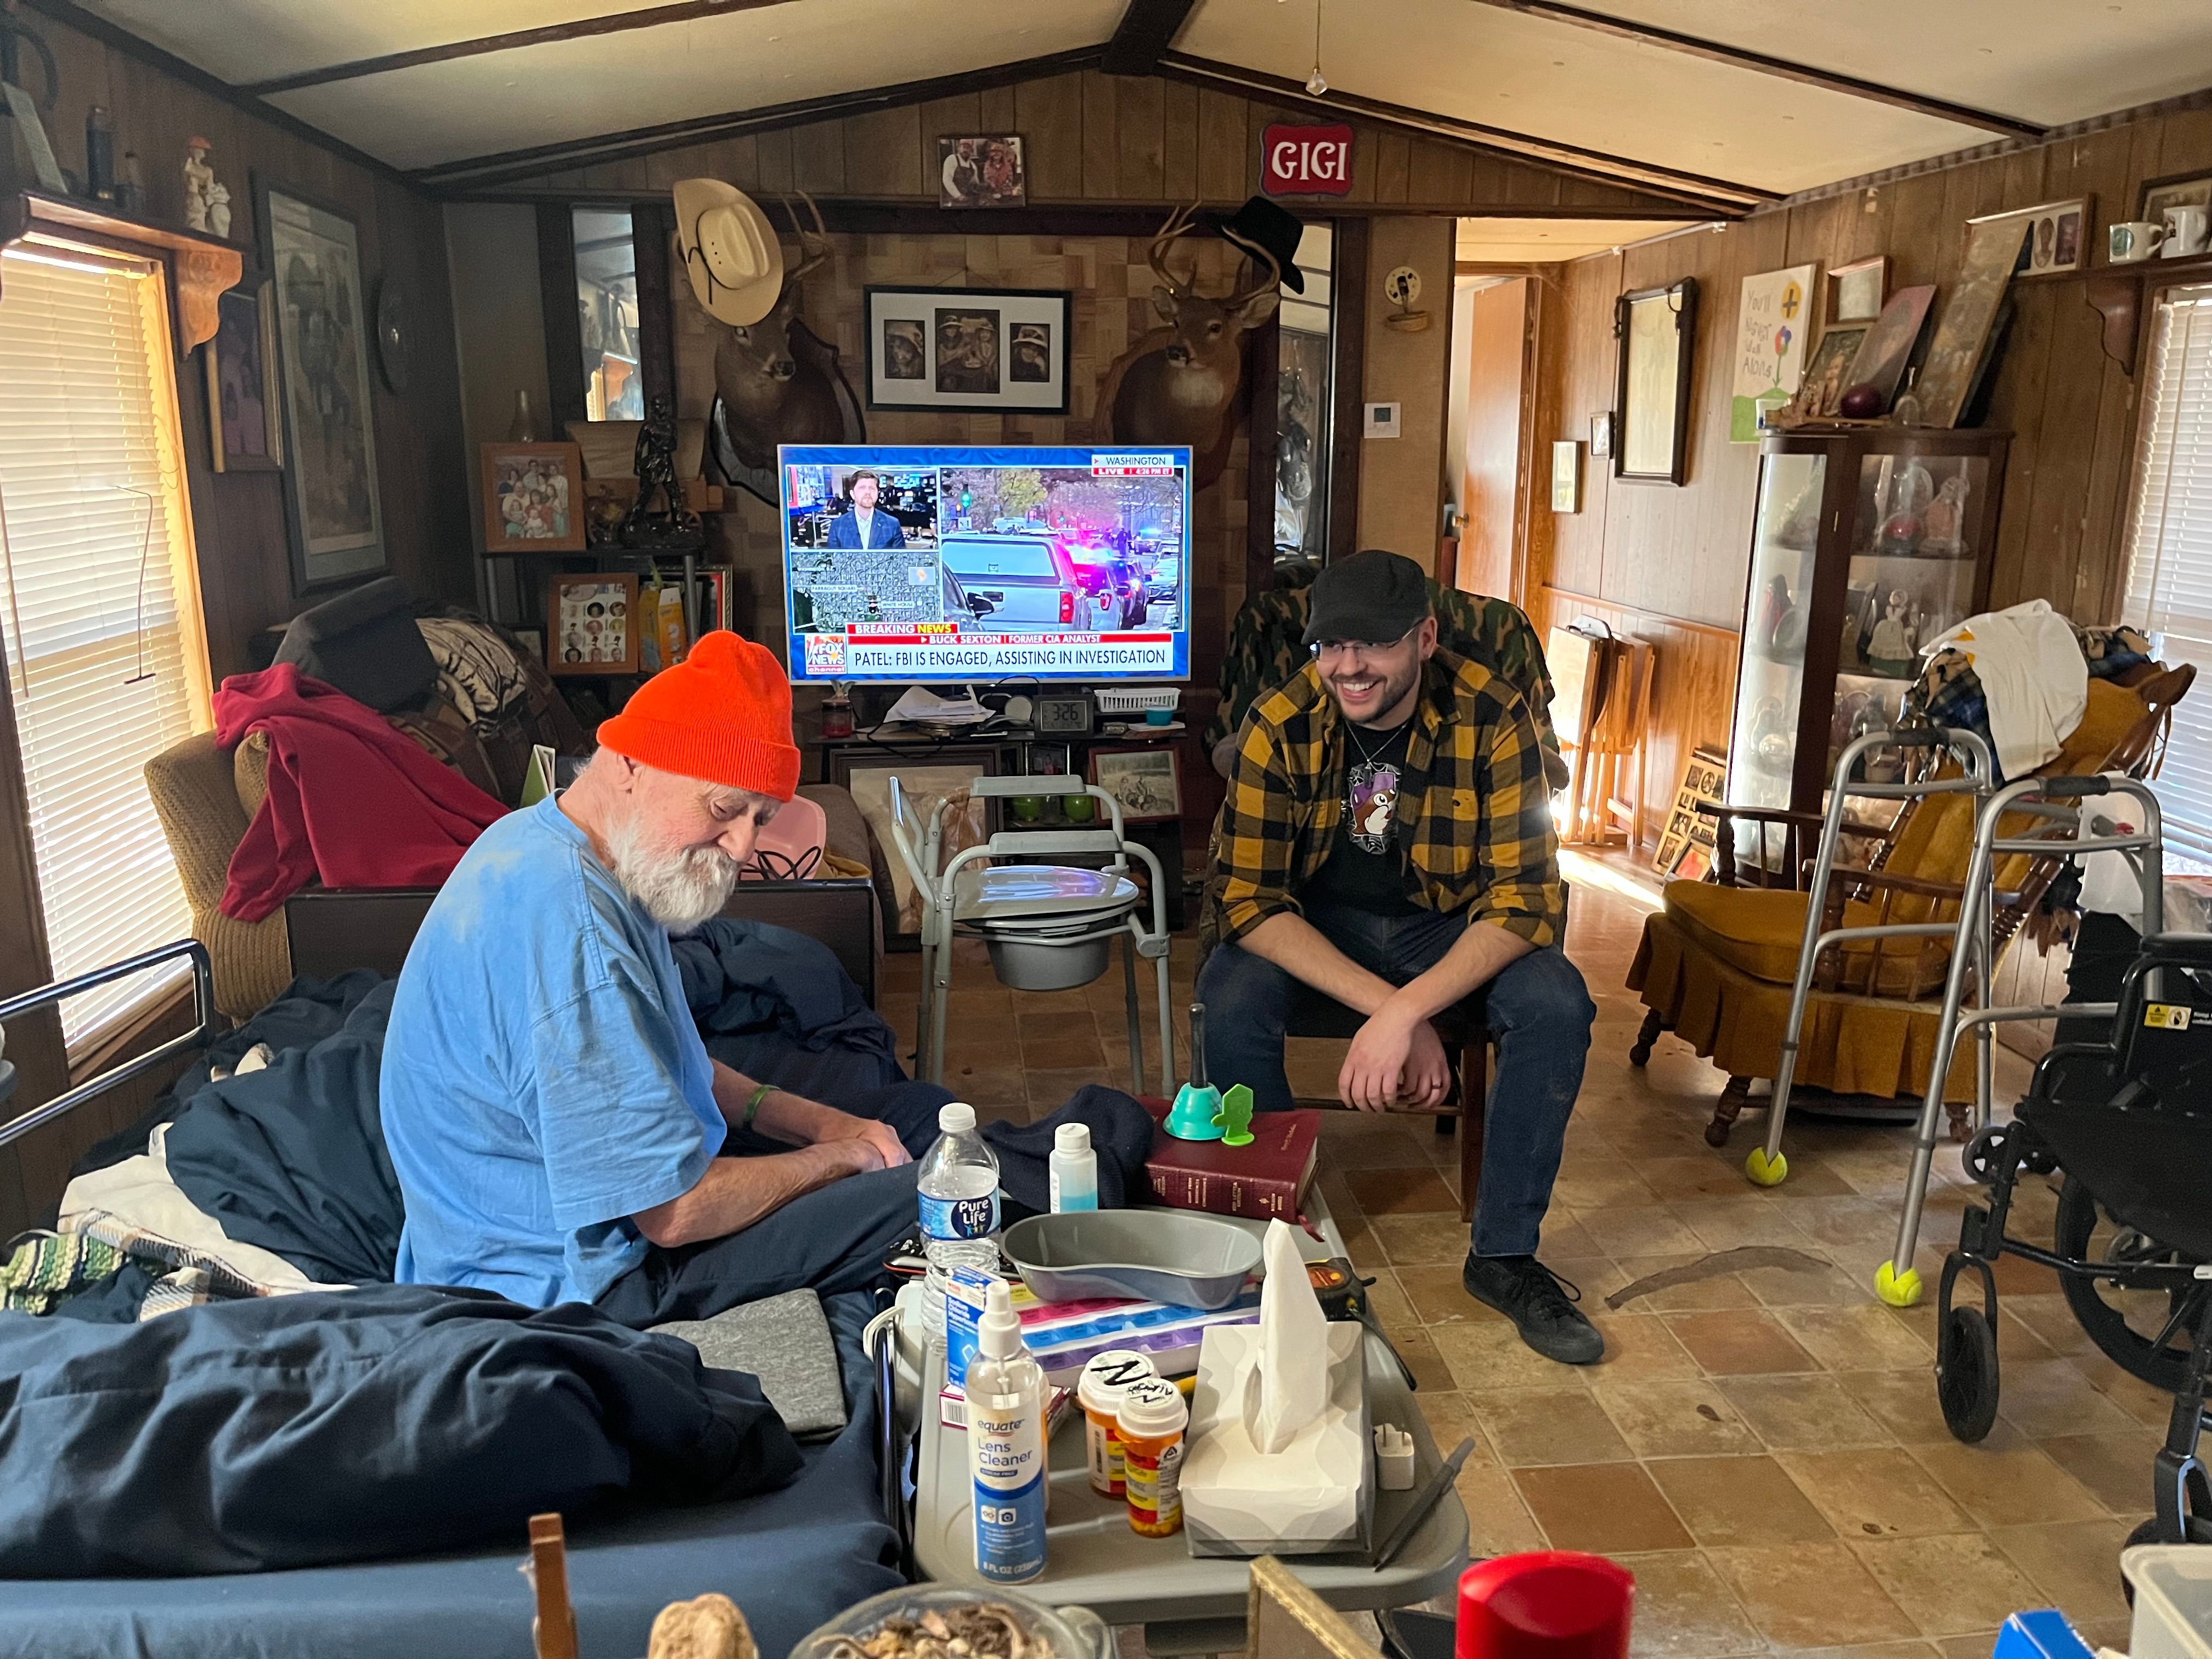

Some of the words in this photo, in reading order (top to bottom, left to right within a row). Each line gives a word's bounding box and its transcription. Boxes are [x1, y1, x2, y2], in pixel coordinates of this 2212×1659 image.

[1272, 142, 1347, 180] GIGI
[1106, 457, 1166, 465] WASHINGTON
[855, 624, 915, 634] BREAKING
[917, 624, 952, 634] NEWS
[929, 636, 957, 644] BUCK
[960, 635, 1001, 644] SEXTON
[1008, 635, 1043, 644] FORMER
[1045, 635, 1060, 644] CIA
[1062, 634, 1101, 644] ANALYST
[819, 643, 844, 654] FOX
[814, 654, 845, 665] NEWS
[855, 652, 891, 666] PATEL:
[896, 652, 911, 665] FBI
[916, 652, 926, 665] IS
[930, 651, 991, 667] ENGAGED,
[995, 651, 1056, 665] ASSISTING
[1060, 651, 1072, 664] IN
[1076, 650, 1165, 664] INVESTIGATION
[1053, 703, 1078, 721] 3:26
[959, 1199, 989, 1213] Pure
[963, 1210, 986, 1226] Life
[947, 1296, 969, 1312] Sodium
[947, 1303, 970, 1320] Chloride
[978, 1419, 1023, 1433] equate
[978, 1436, 1011, 1453] Lens
[979, 1449, 1033, 1466] Cleaner
[1000, 1566, 1012, 1574] OZ
